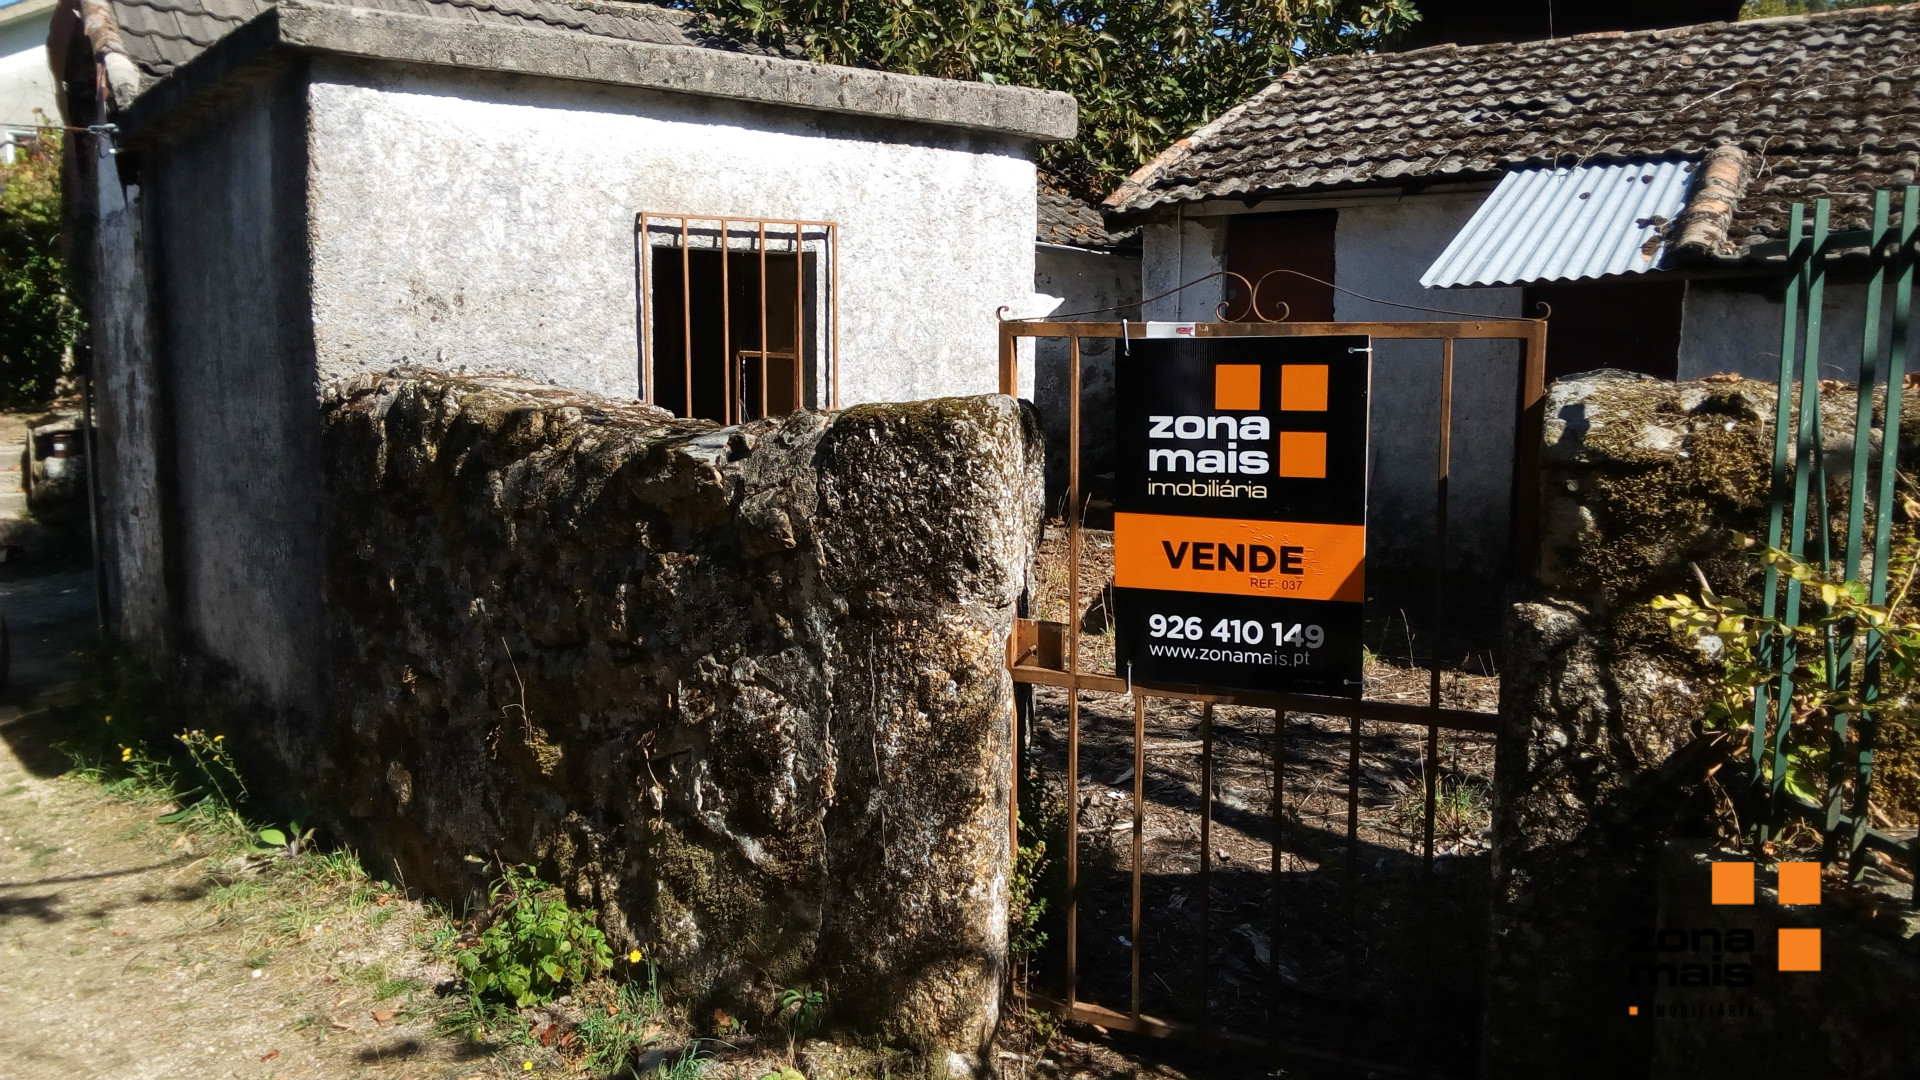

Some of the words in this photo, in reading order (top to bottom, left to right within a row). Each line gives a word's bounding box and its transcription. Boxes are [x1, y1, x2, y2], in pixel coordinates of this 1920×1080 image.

[1149, 415, 1270, 441] zona
[1149, 442, 1270, 475] mais
[1148, 478, 1268, 499] imobiliária
[1161, 541, 1304, 575] VENDE
[1250, 577, 1279, 589] REF:
[1281, 579, 1303, 591] 037
[1149, 613, 1203, 641] 926
[1210, 618, 1264, 645] 410
[1271, 622, 1325, 649] 149
[1149, 643, 1310, 667] www.zonamais.pt
